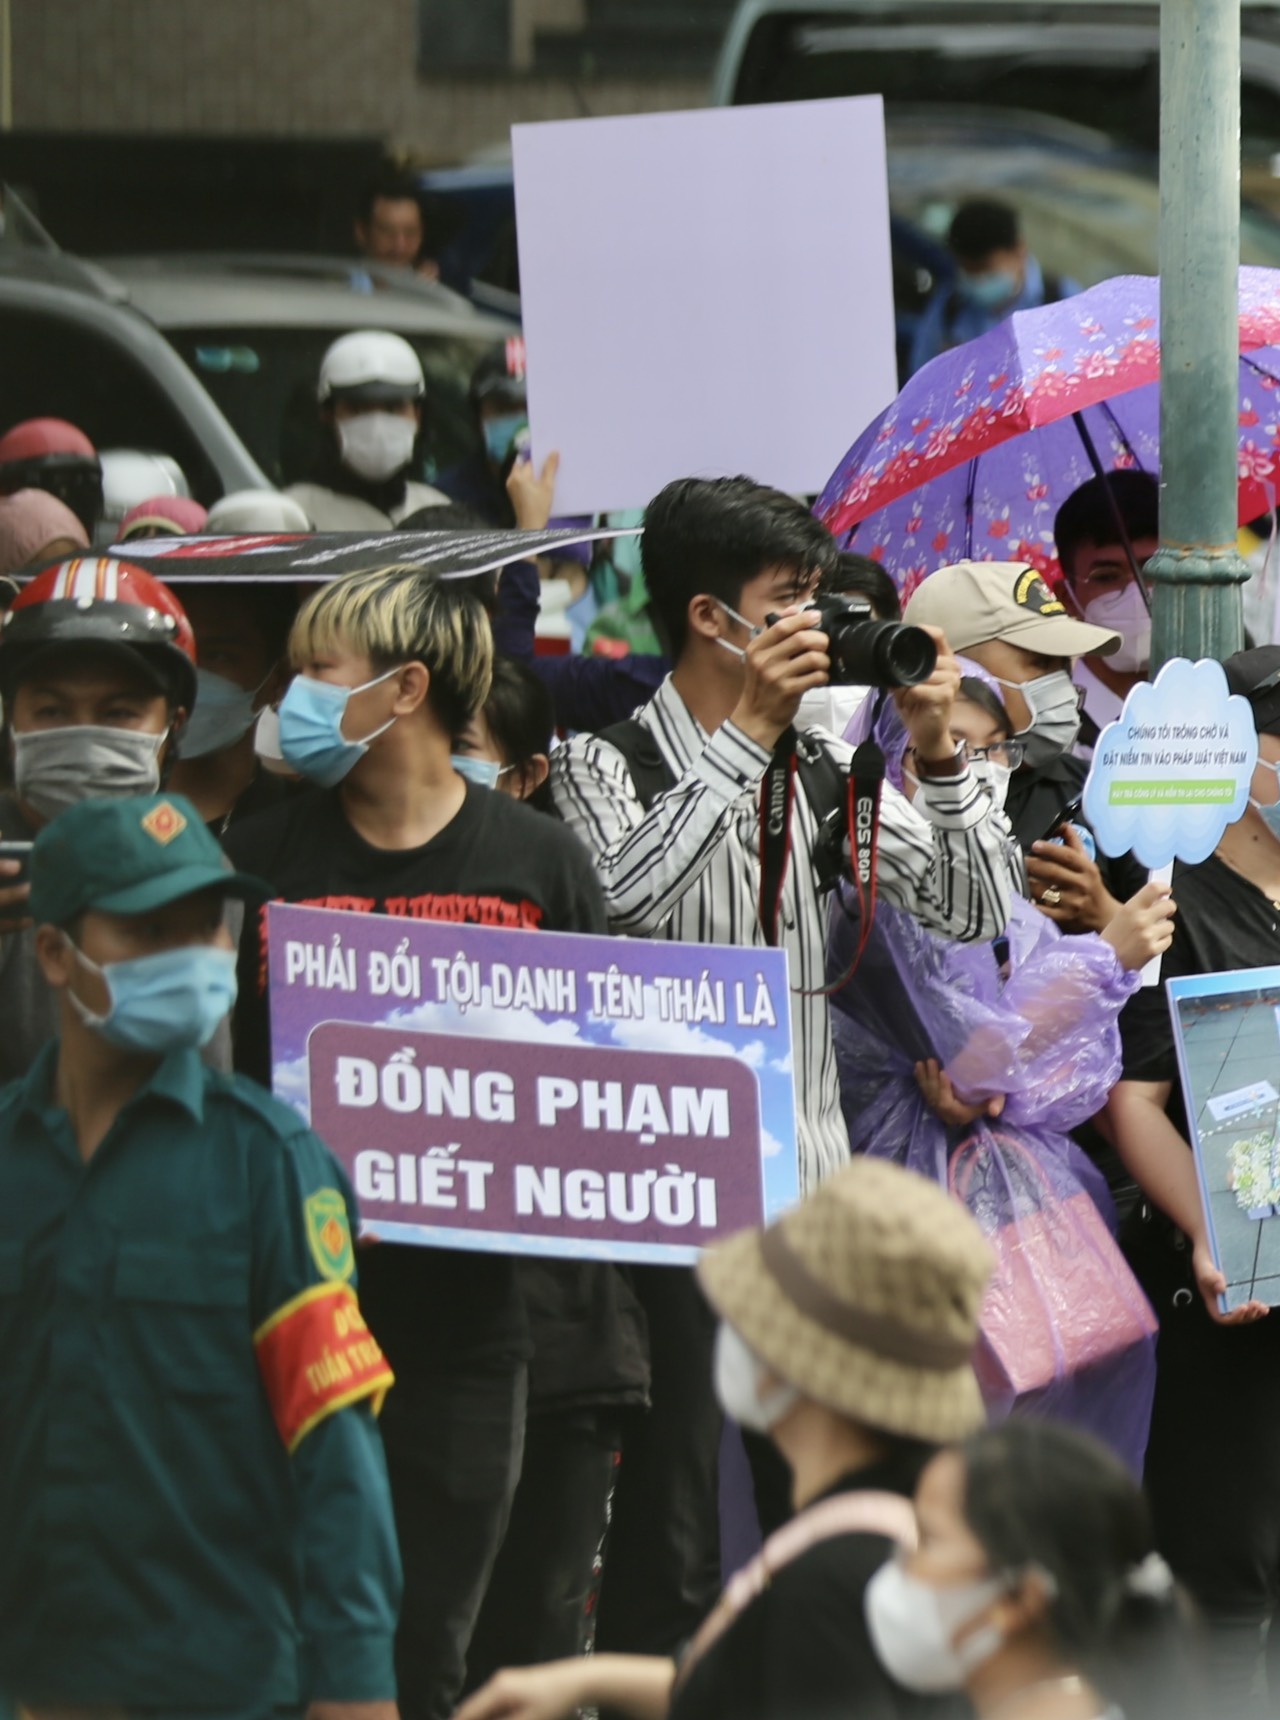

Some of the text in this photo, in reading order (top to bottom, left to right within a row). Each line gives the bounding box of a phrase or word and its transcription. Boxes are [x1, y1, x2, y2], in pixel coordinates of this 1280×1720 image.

[1103, 746, 1248, 769] ĐẶT NIỀM TIN VÀO PHÁP LUẬT VIỆT NAM
[1127, 723, 1157, 740] CHÚNG
[1158, 722, 1171, 739] TÔI
[1199, 722, 1218, 739] CHỜ
[768, 769, 785, 835] Canon
[856, 796, 873, 883] EOS 80D
[285, 933, 357, 991] PHẢI
[368, 937, 421, 998] ĐỔI
[431, 950, 482, 1015] TỘI
[490, 963, 577, 1014] DANH
[587, 964, 644, 1018] TÊN
[654, 969, 726, 1024] THÁI
[735, 972, 777, 1026] LÀ
[334, 1046, 731, 1144] ĐỒNG PHẠM
[354, 1143, 718, 1228] GIẾT NGƯỜI
